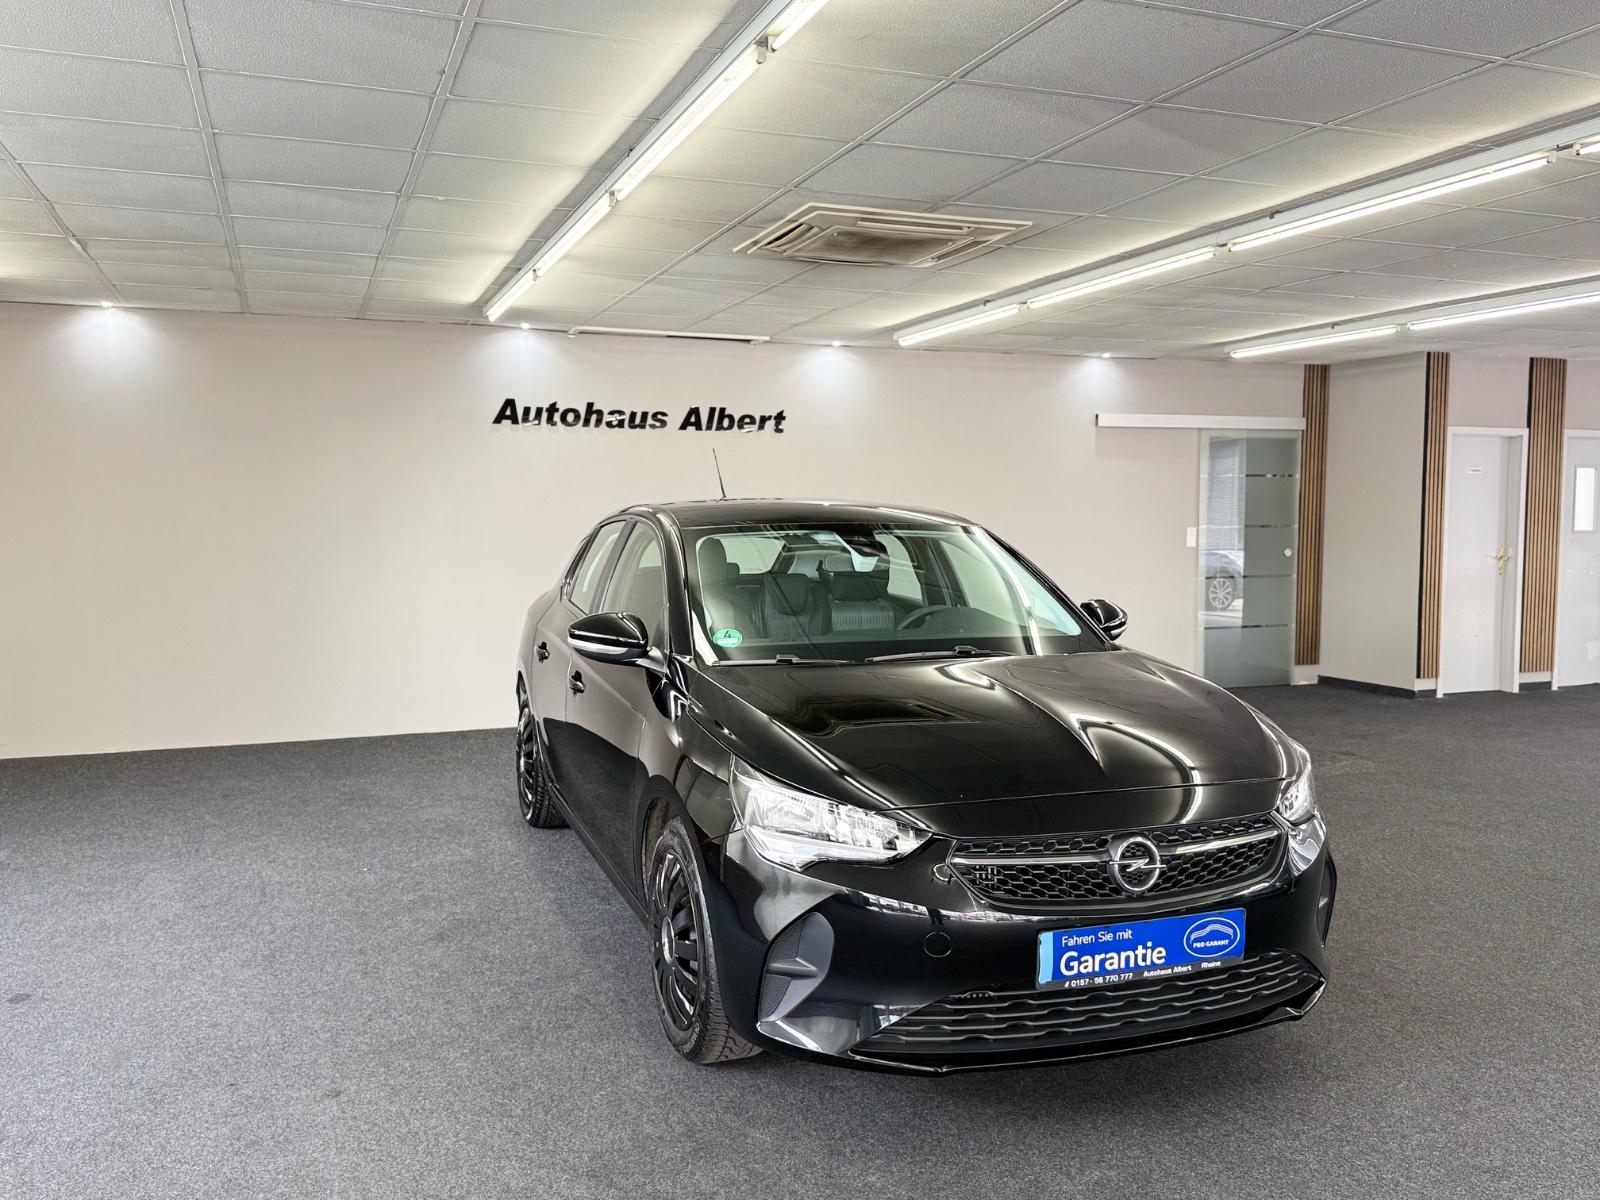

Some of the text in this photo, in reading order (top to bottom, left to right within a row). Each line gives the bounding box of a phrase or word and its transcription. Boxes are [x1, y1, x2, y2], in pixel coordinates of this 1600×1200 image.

[492, 398, 786, 433] Autohaus Albert
[723, 630, 732, 638] 4
[1061, 929, 1133, 947] Fahren Sie mit
[1205, 939, 1229, 947] GARANT
[1060, 941, 1166, 976] Garantie
[1120, 972, 1133, 981] 777
[1143, 967, 1172, 977] Autohaus
[1173, 965, 1192, 973] Albert
